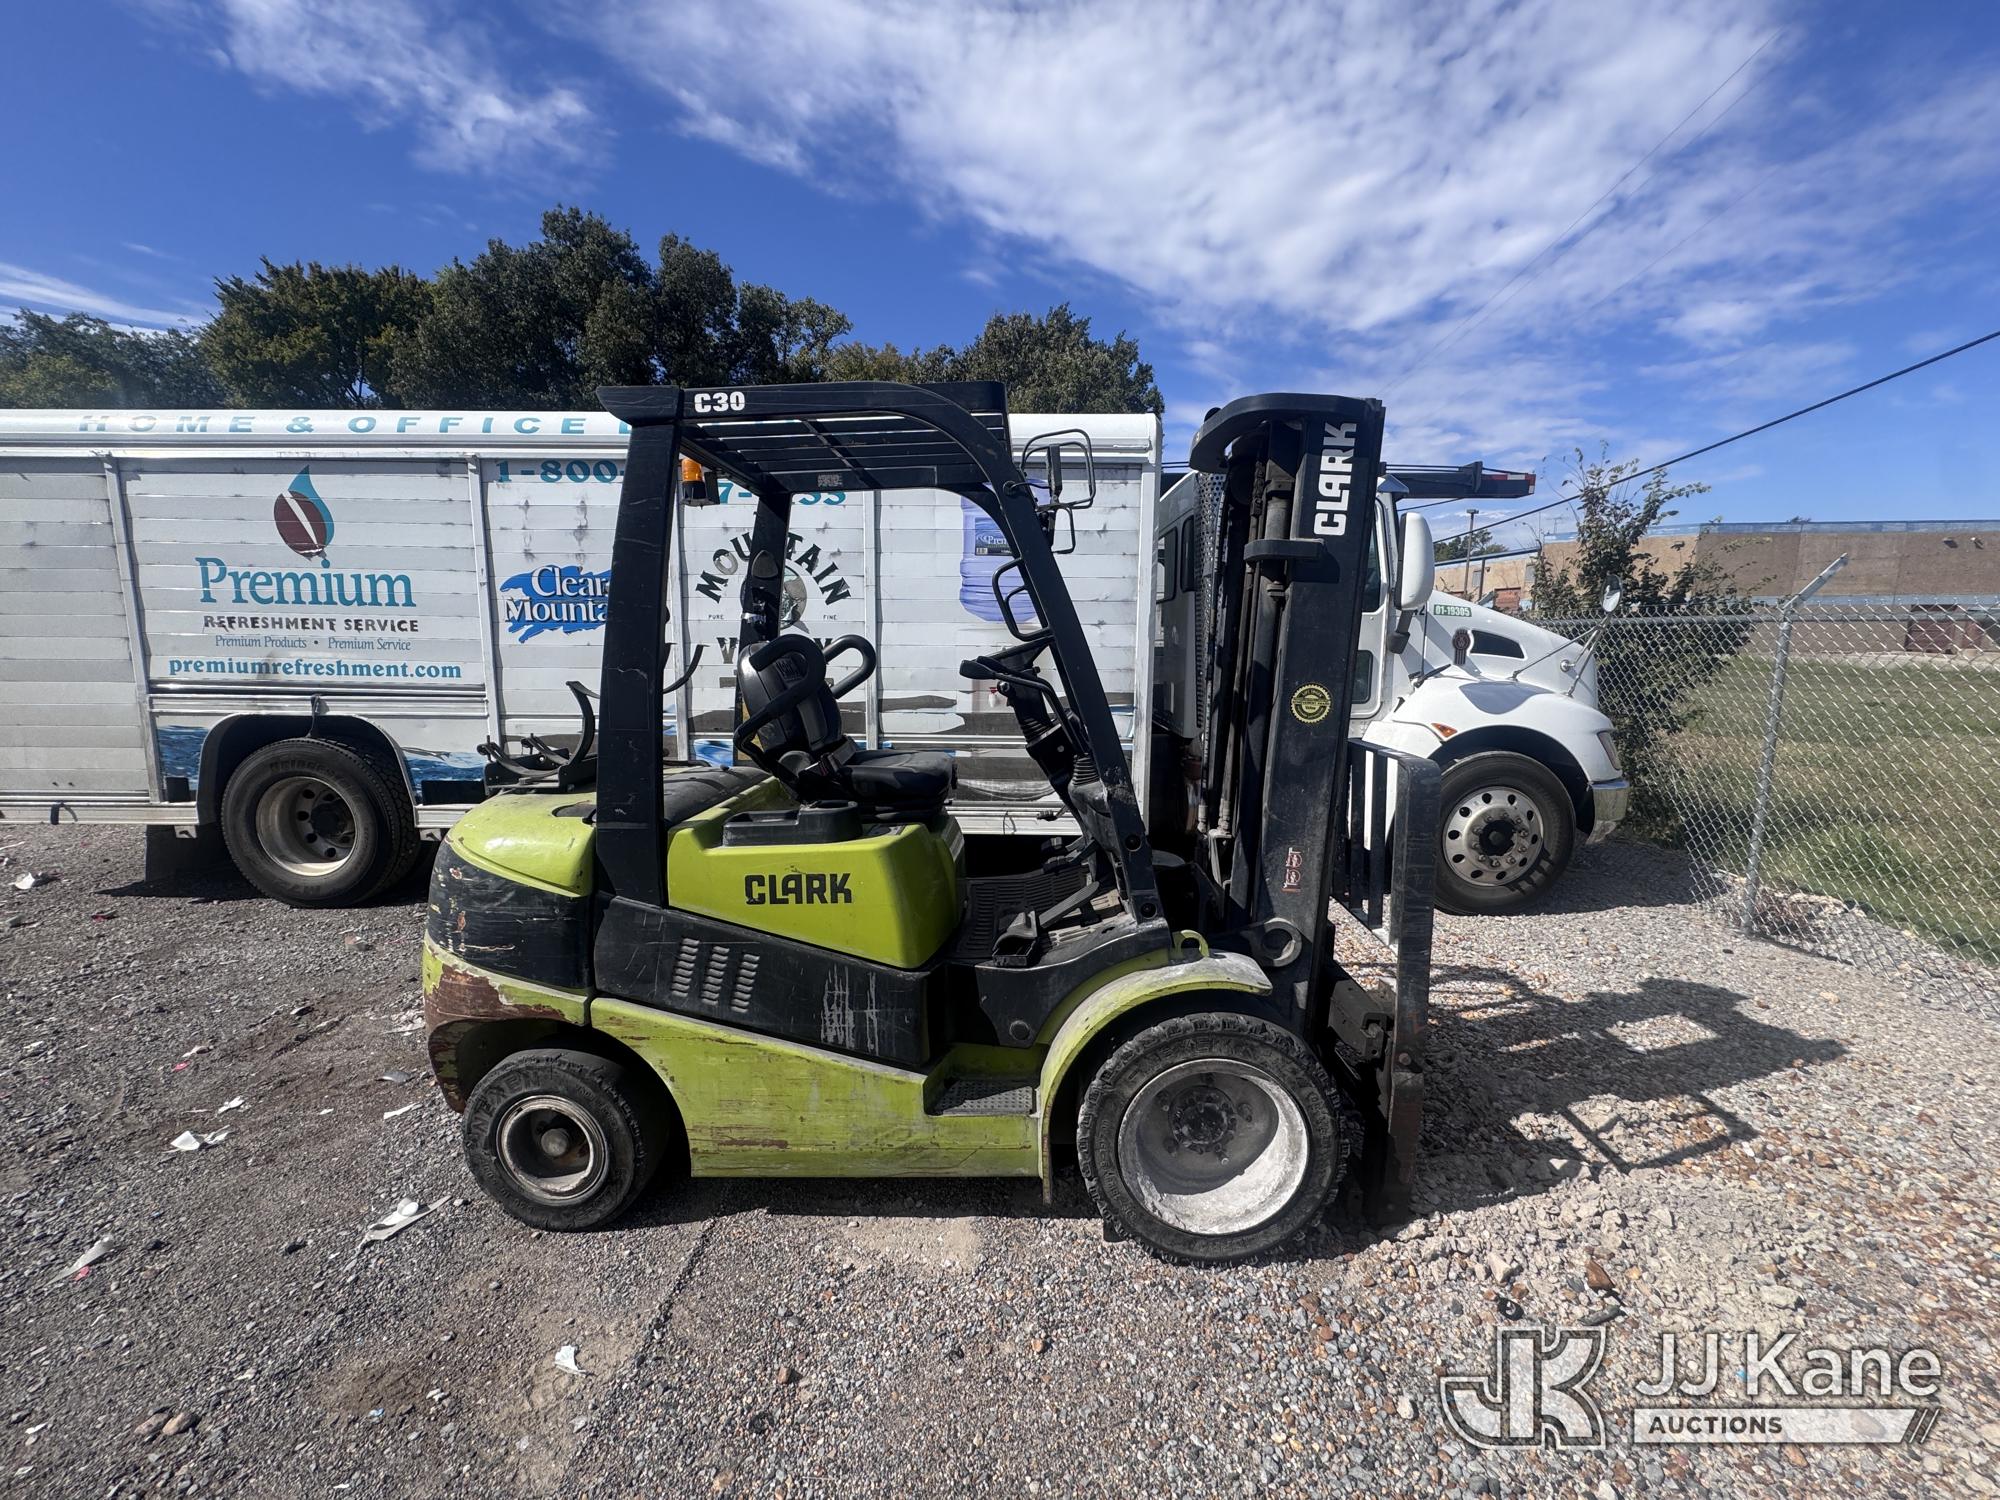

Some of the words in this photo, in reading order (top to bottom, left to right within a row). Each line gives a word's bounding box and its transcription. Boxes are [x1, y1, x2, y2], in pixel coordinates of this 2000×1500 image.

[694, 391, 745, 413] C30
[79, 415, 256, 433] HOME
[286, 416, 314, 433] &
[347, 416, 587, 434] OFFICE
[1314, 422, 1357, 536] CLARK
[695, 531, 852, 606] MOUTAIN
[195, 556, 417, 608] Premium
[531, 566, 609, 597] Clear
[1435, 605, 1470, 617] 01-19305
[203, 615, 337, 632] REFRESHMENT
[343, 618, 419, 632] SERVICE
[215, 635, 261, 648] Premium
[264, 635, 307, 649] Products
[328, 637, 374, 650] Premium
[376, 637, 411, 651] Service
[169, 657, 462, 679] premiumrefreshment.com
[744, 873, 852, 905] CLARK
